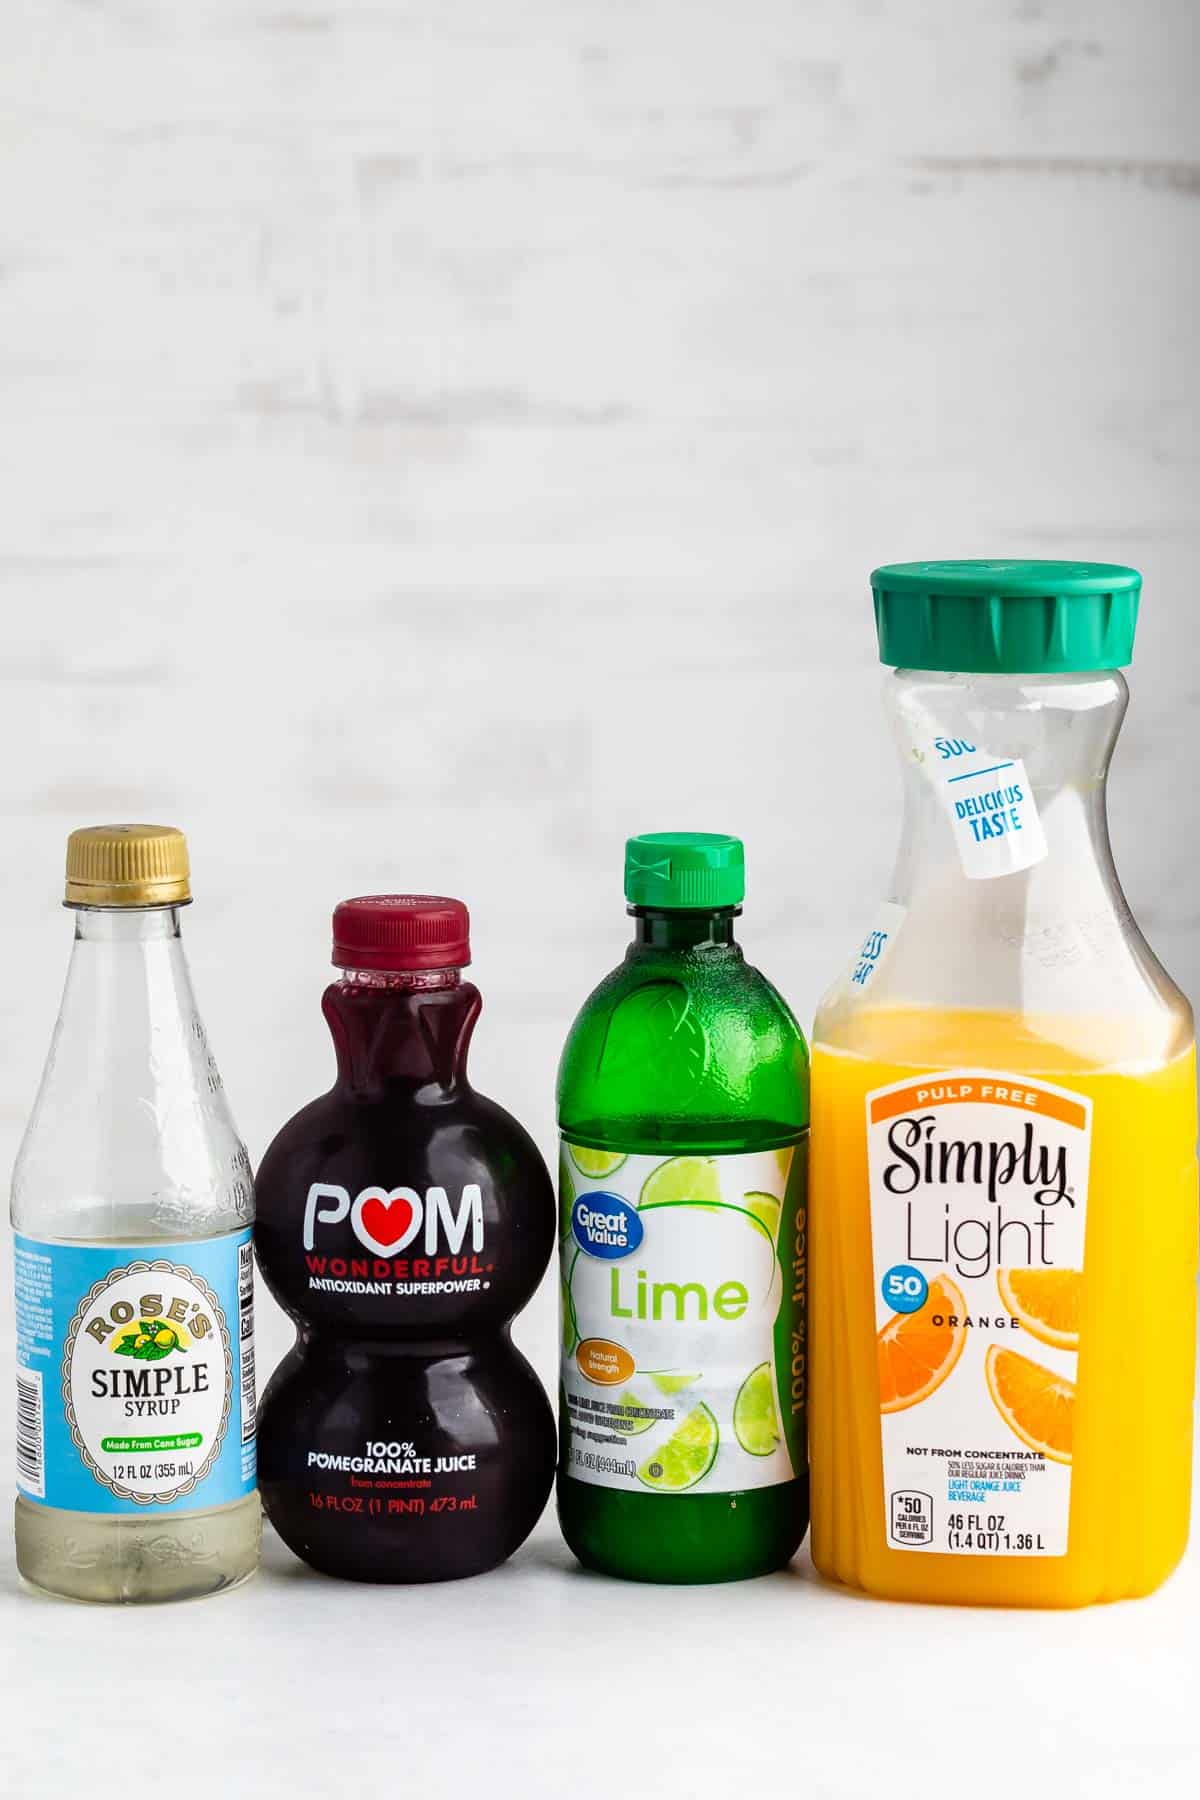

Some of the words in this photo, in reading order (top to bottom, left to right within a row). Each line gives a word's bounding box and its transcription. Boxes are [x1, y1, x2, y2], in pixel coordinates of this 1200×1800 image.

[970, 808, 1022, 841] TASTE
[917, 1085, 973, 1102] PULP
[981, 1086, 1038, 1105] FREE
[884, 1116, 1075, 1208] Simply
[304, 1183, 484, 1258] POM
[577, 1204, 627, 1232] Great
[587, 1228, 627, 1247] Value
[907, 1202, 1055, 1278] Light
[305, 1255, 484, 1278] WONDERFUL
[309, 1277, 392, 1294] ANTIOXIDANT
[396, 1279, 480, 1294] SUPERPOWER
[611, 1267, 749, 1321] Lime
[889, 1275, 922, 1296] 50
[85, 1294, 212, 1344] ROSE'S
[932, 1315, 1020, 1328] ORANGE
[590, 1351, 617, 1363] Natural
[588, 1360, 620, 1374] Strength
[792, 1321, 805, 1414] 100%
[91, 1363, 209, 1398] SIMPLE
[124, 1398, 180, 1417] SYRUP
[106, 1440, 129, 1449] Made
[131, 1440, 152, 1449] From
[154, 1439, 174, 1448] Cane
[176, 1437, 199, 1448] Sugar
[366, 1441, 416, 1457] 100%
[308, 1452, 431, 1473] POMEGRANATE
[434, 1455, 476, 1472] JUICE
[906, 1447, 928, 1456] NOT
[931, 1448, 961, 1458] FROM
[964, 1450, 1045, 1460] CONCENTRATE
[113, 1465, 124, 1479] 12
[128, 1465, 137, 1479] FL
[140, 1465, 151, 1478] OZ
[154, 1463, 175, 1479] (355
[178, 1461, 194, 1477] mL)
[976, 1462, 994, 1471] SUGAR
[1002, 1463, 1028, 1472] CALORIES
[1030, 1463, 1045, 1472] THAN
[375, 1478, 431, 1488] concentrate
[948, 1480, 967, 1490] LIGHT
[970, 1480, 1000, 1491] ORANGE
[1002, 1481, 1021, 1492] JUICE
[310, 1493, 323, 1508] 16
[429, 1496, 456, 1512] 473
[459, 1495, 478, 1509] mL
[948, 1491, 985, 1502] BEVERAGE
[948, 1514, 963, 1530] 46
[968, 1515, 983, 1530] FL
[988, 1516, 1005, 1531] OZ
[948, 1531, 972, 1549] (1.4
[978, 1533, 999, 1549] QT)
[1004, 1534, 1032, 1549] 1.36
[1037, 1535, 1044, 1549] L
